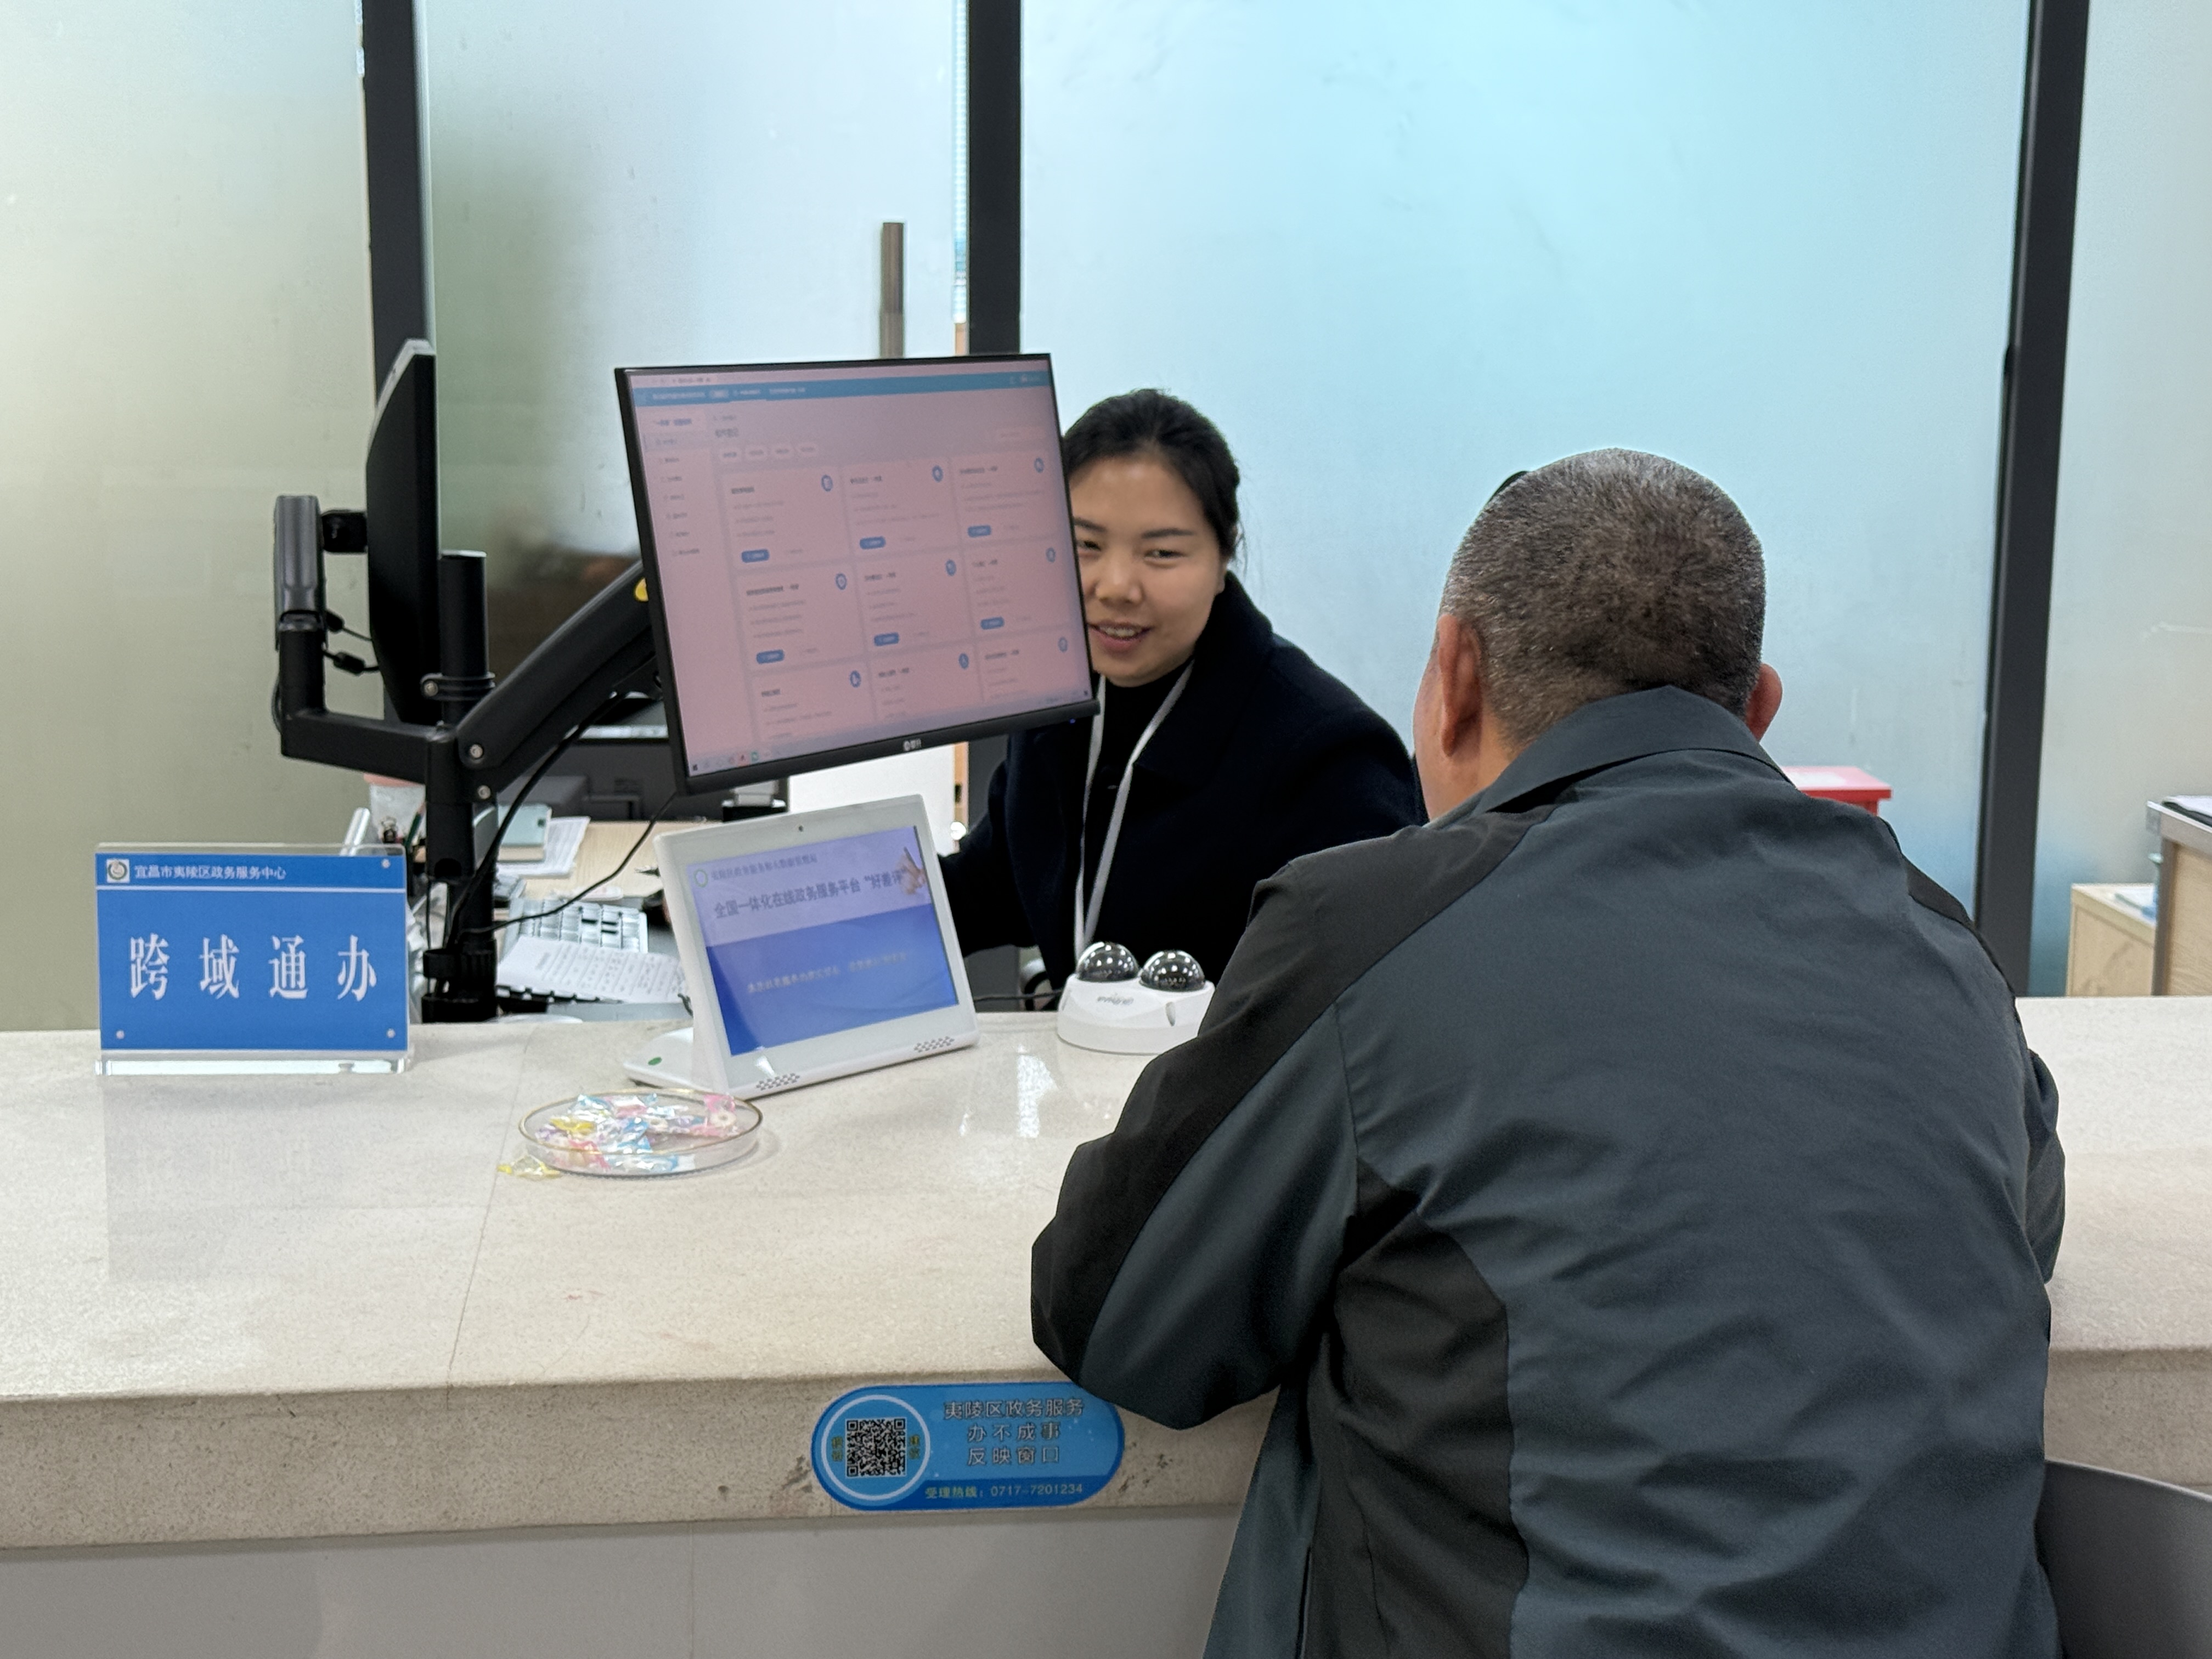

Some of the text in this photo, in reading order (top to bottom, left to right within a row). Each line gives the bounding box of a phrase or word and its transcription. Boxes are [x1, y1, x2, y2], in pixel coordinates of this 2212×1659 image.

[134, 864, 286, 881] 宜昌市夷陵区政务服务中心
[129, 933, 377, 1001] 跨域通办
[945, 1399, 1084, 1420] 夷陵区政务服务
[968, 1423, 1059, 1442] 办不成事
[968, 1446, 1059, 1466] 反映窗口
